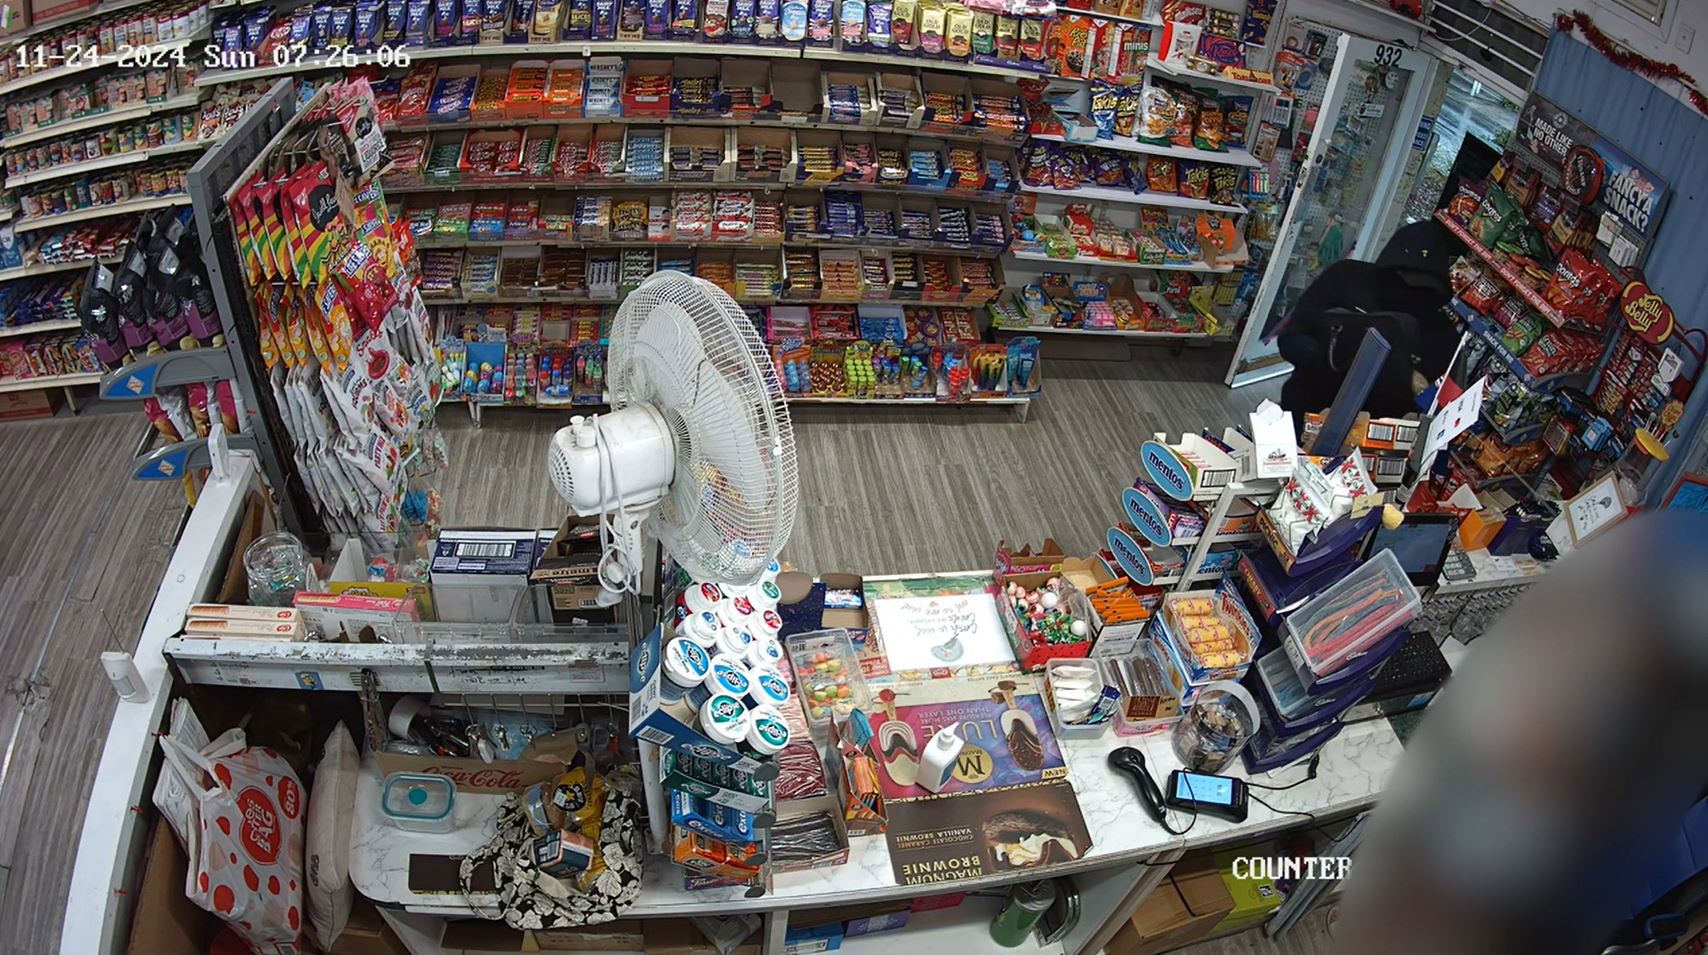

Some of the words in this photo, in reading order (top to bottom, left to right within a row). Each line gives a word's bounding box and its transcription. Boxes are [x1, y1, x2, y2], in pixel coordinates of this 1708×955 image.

[1123, 41, 1149, 51] minis
[1373, 44, 1403, 67] 932
[1091, 95, 1118, 112] Takis
[1118, 95, 1140, 112] akis
[1534, 127, 1546, 141] NO
[1544, 133, 1568, 157] OTHER
[1535, 118, 1558, 139] MADE
[1556, 131, 1574, 149] LIKE
[1609, 171, 1649, 206] FANCY
[1643, 197, 1654, 215] A
[1604, 187, 1649, 233] SNACK?
[1556, 262, 1581, 288] Doritos
[1625, 301, 1654, 332] Belly
[1636, 297, 1663, 324] Jelly
[1482, 330, 1501, 348] SNACK
[1149, 452, 1185, 490] mentos
[1130, 498, 1164, 536] mentos
[1114, 537, 1146, 576] mentos
[1042, 767, 1067, 778] NEW
[895, 832, 934, 844] BROWNIE
[896, 839, 931, 849] CARAMEL
[932, 834, 974, 846] CHOCOLATE
[937, 828, 973, 839] VANILLA
[902, 855, 981, 876] BROWNIE
